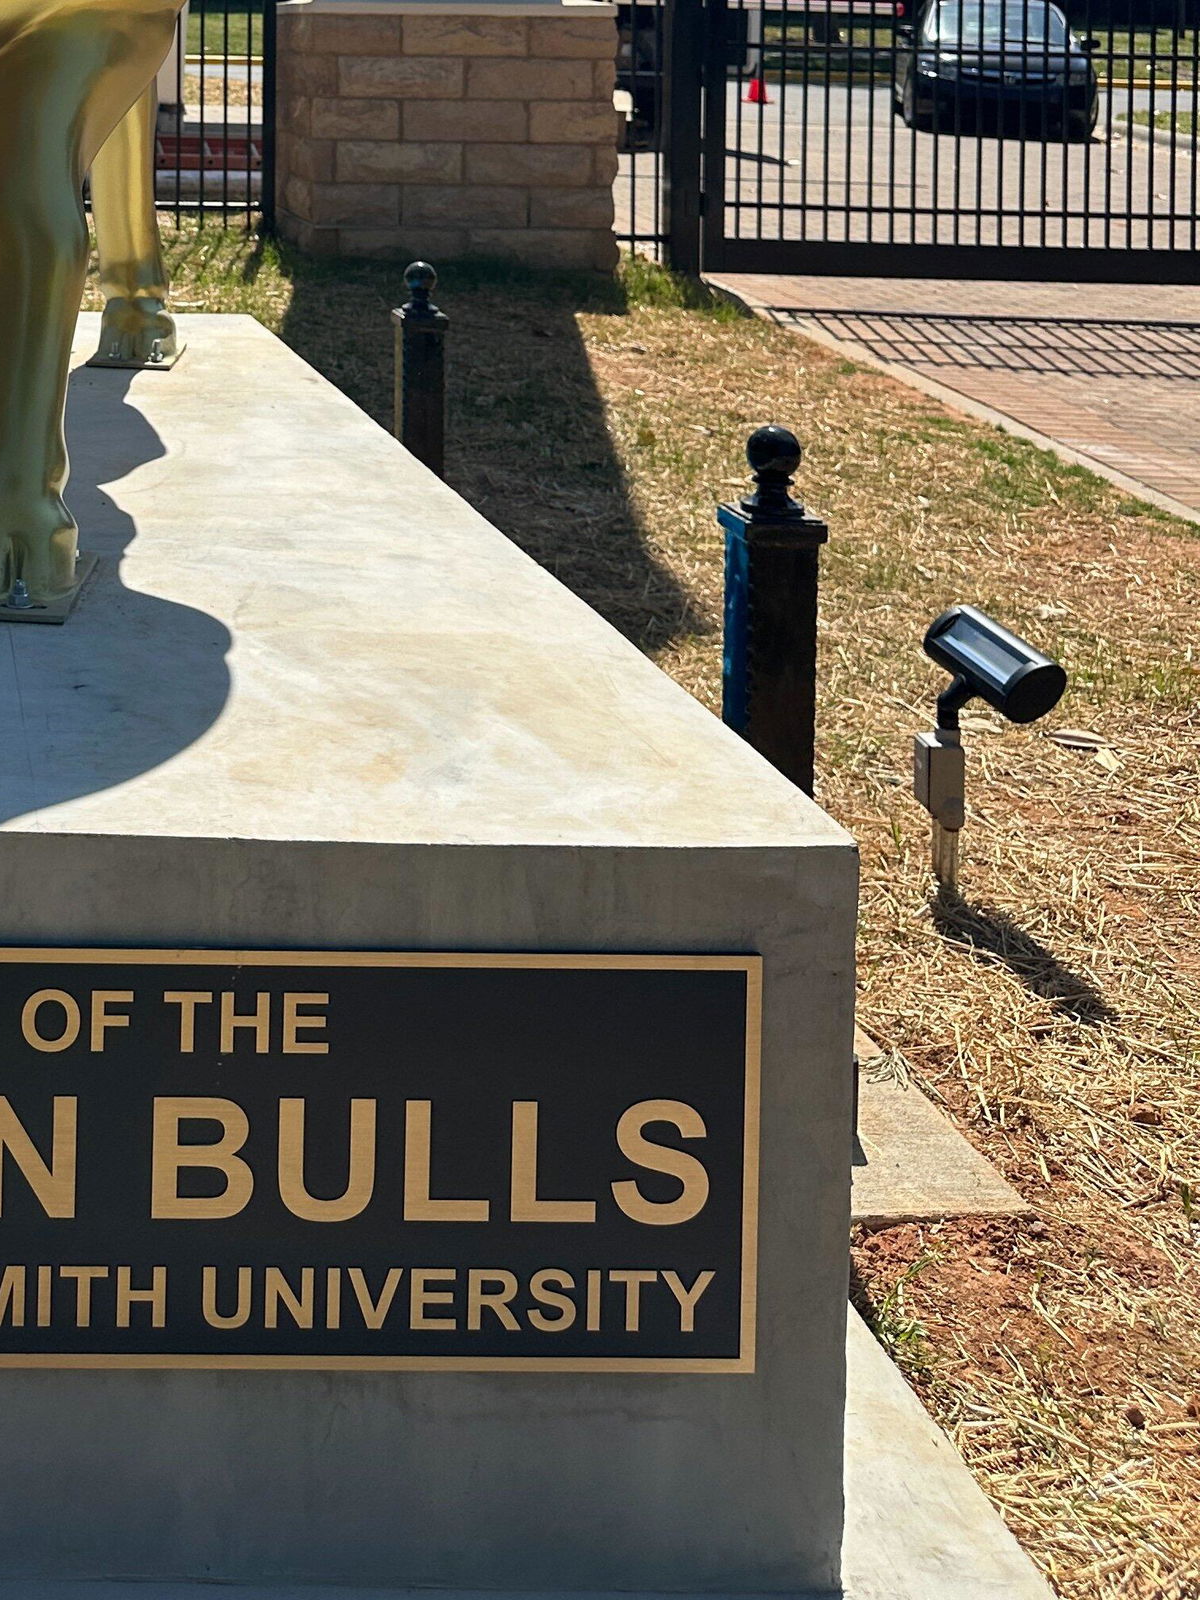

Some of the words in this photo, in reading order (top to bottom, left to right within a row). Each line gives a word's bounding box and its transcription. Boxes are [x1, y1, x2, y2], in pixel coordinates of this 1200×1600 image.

[20, 988, 135, 1053] OF
[162, 991, 331, 1054] THE
[149, 1096, 711, 1227] BULLS
[201, 1266, 716, 1334] UNIVERSITY
